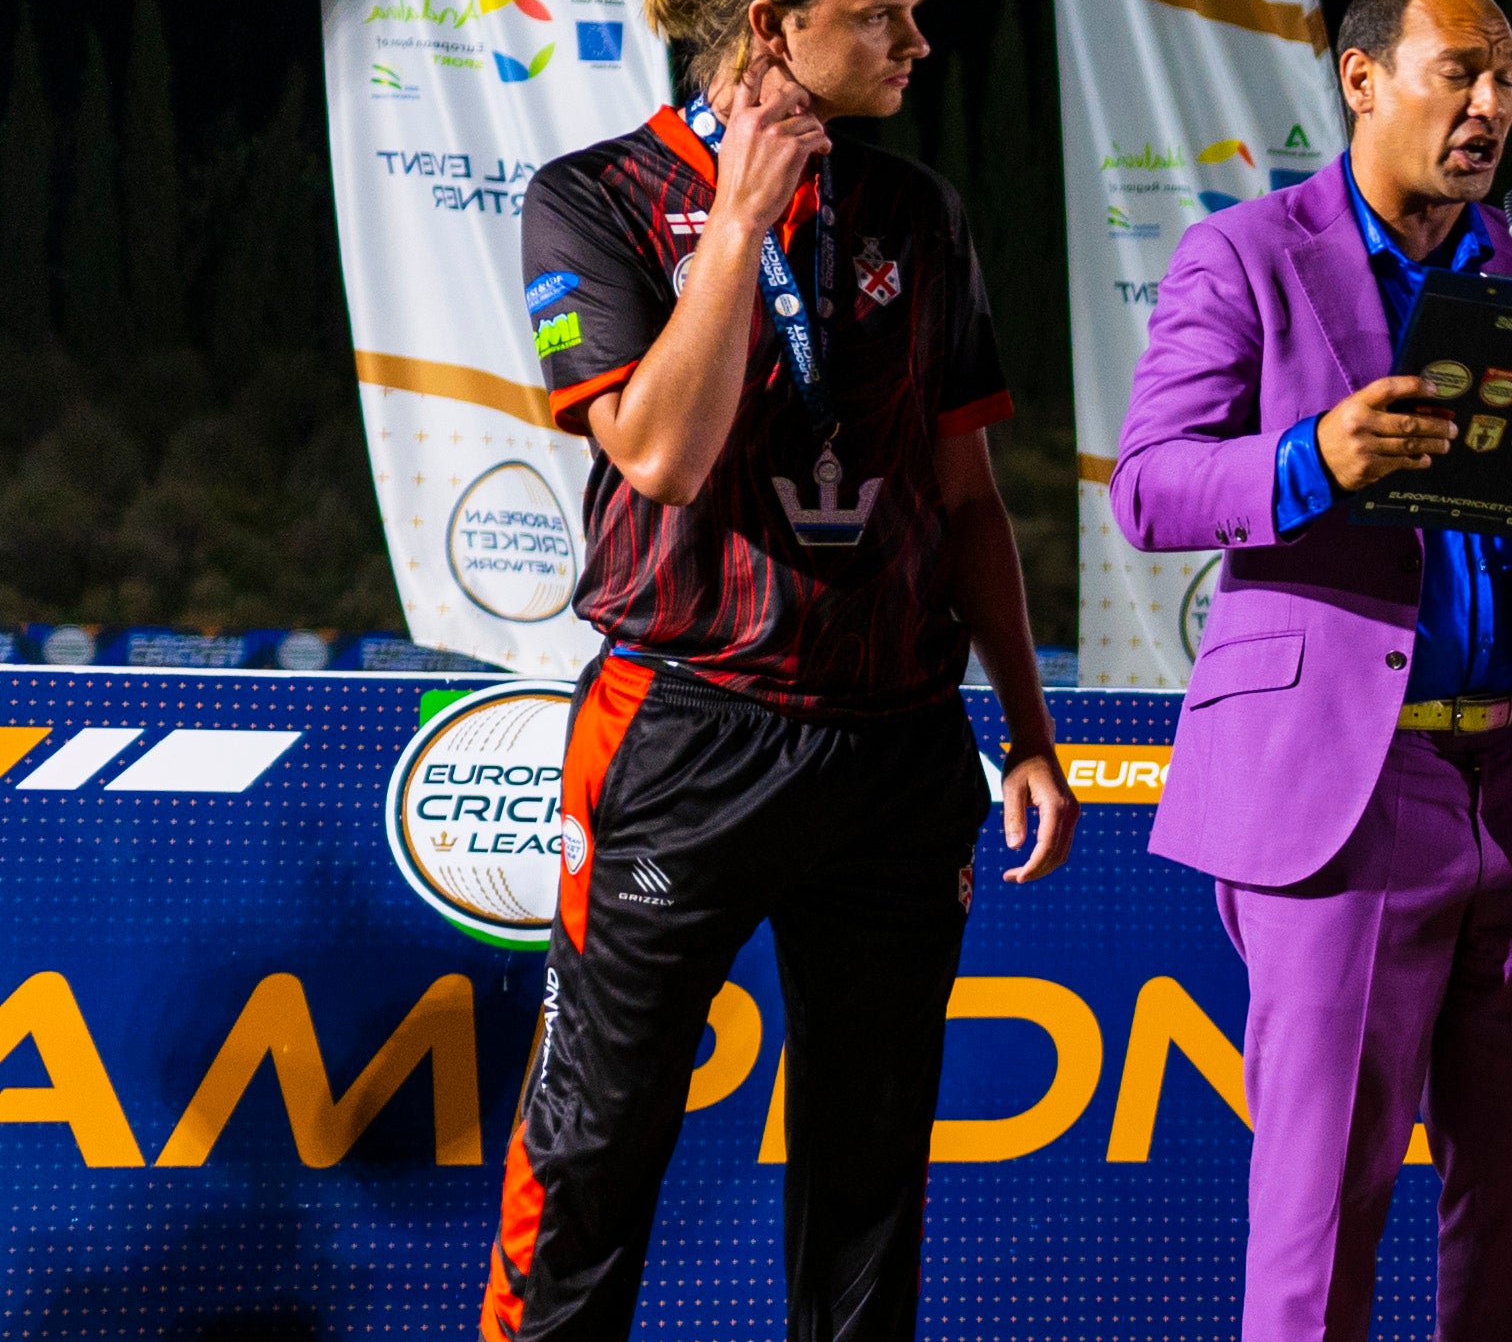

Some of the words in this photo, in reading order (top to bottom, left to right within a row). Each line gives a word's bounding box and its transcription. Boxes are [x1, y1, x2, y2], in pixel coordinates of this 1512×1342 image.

[786, 325, 811, 384] EUROPEAN
[793, 323, 821, 382] CRICKET
[422, 763, 561, 787] EUROP
[418, 793, 561, 824] CRIC
[467, 832, 561, 855] LEAG
[618, 891, 675, 907] GRIZZLY
